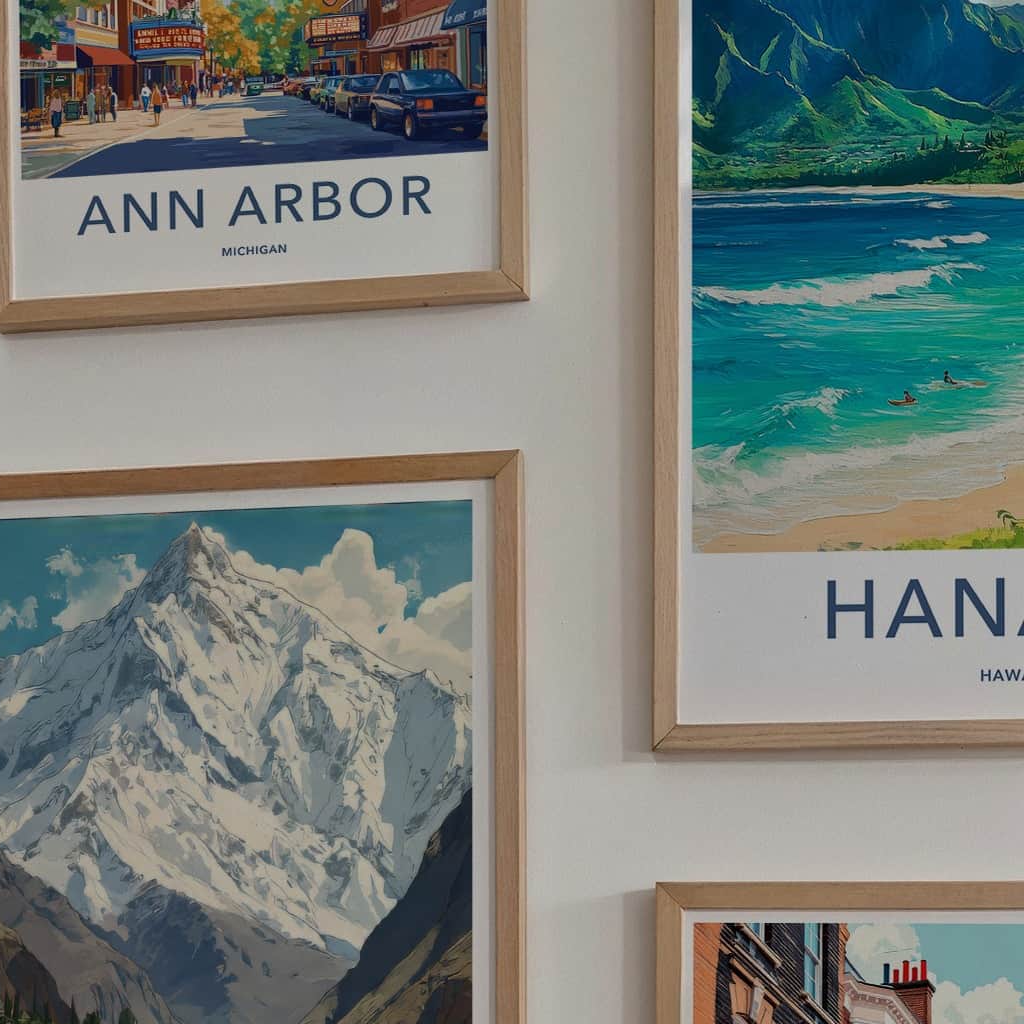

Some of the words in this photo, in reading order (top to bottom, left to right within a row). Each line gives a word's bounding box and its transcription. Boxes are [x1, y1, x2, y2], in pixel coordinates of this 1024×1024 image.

[77, 188, 205, 237] ANN
[228, 175, 432, 227] ARBOR
[221, 243, 288, 257] MICHIGAN
[980, 668, 1024, 683] HAW
